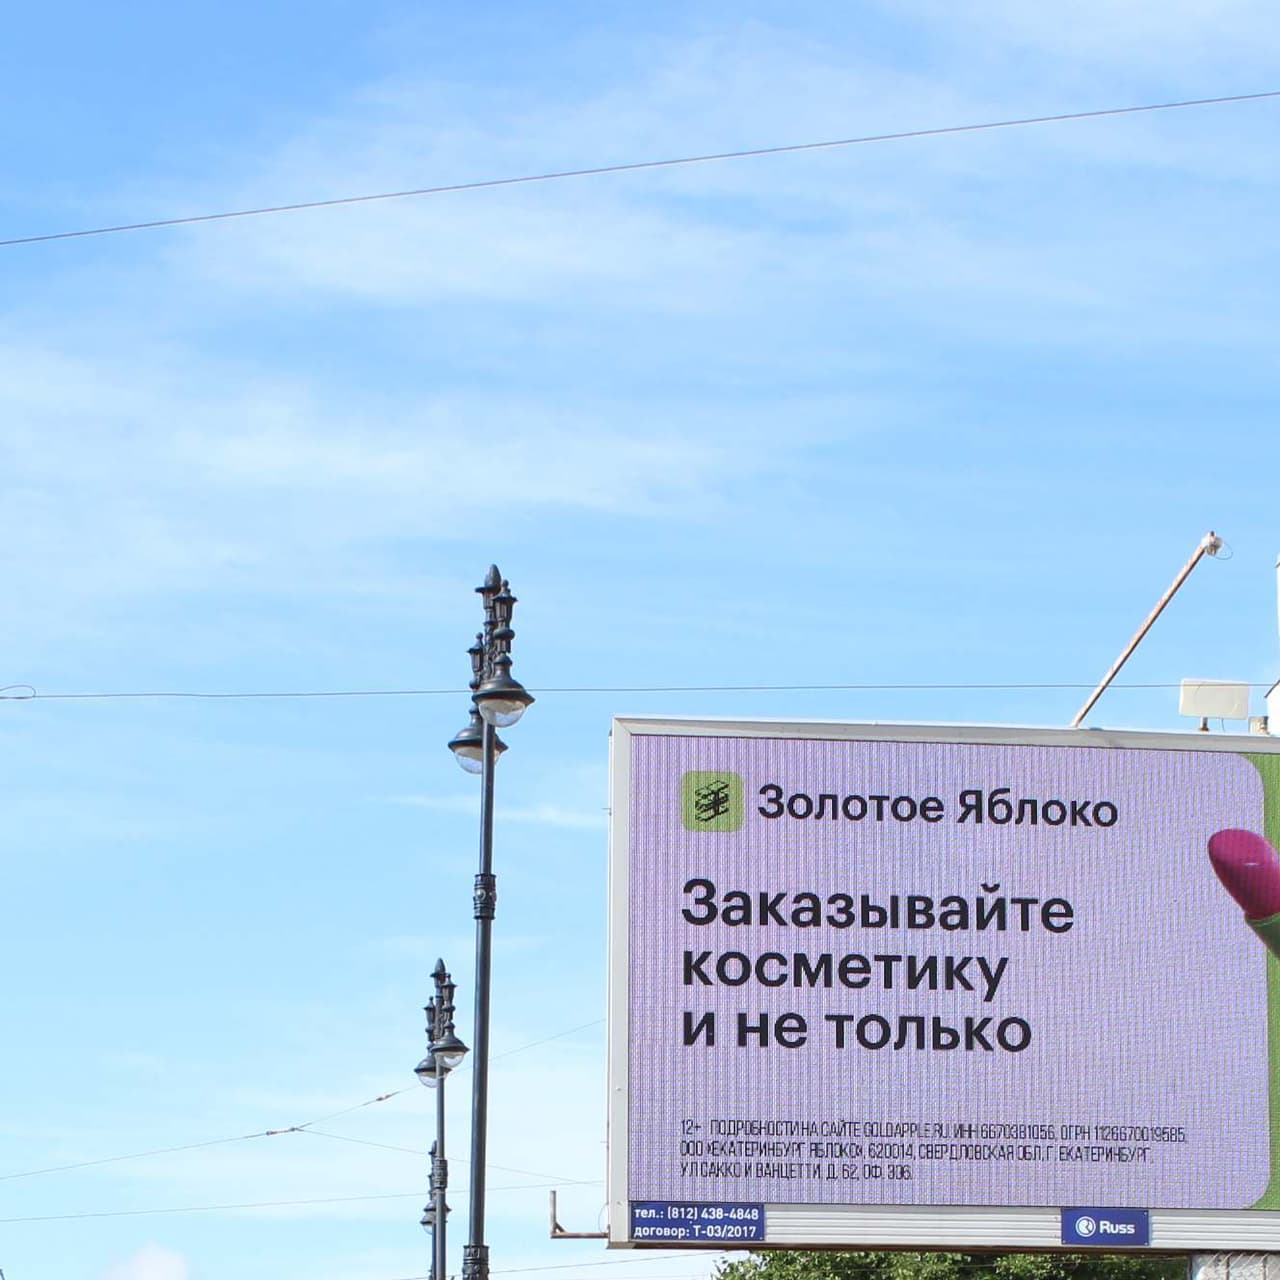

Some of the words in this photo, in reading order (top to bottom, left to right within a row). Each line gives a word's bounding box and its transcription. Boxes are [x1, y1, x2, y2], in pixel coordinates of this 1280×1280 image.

[758, 783, 944, 822] Золотое
[957, 788, 1118, 827] Яблоко
[682, 878, 1074, 933] Заказывайте
[683, 951, 1009, 1002] косметику
[683, 1012, 715, 1046] и
[738, 1013, 808, 1049] не
[825, 1014, 1032, 1052] только
[681, 1119, 702, 1135] 12+
[710, 1119, 799, 1137] ПОДРОБНОСТИ
[801, 1121, 819, 1136] НА
[821, 1119, 861, 1137] САЙТЕ
[1060, 1125, 1091, 1140] ОГРН
[680, 1140, 704, 1157] ООО
[918, 1144, 1015, 1161] СВЕРДЛОВСКАЯ
[744, 1163, 753, 1178] И
[634, 1208, 664, 1218] тел.:
[667, 1206, 698, 1220] (812)
[701, 1208, 759, 1220] 438-4848
[633, 1226, 690, 1239] договор:
[693, 1225, 757, 1238] Т-03/2017
[1099, 1220, 1136, 1235] Russ
